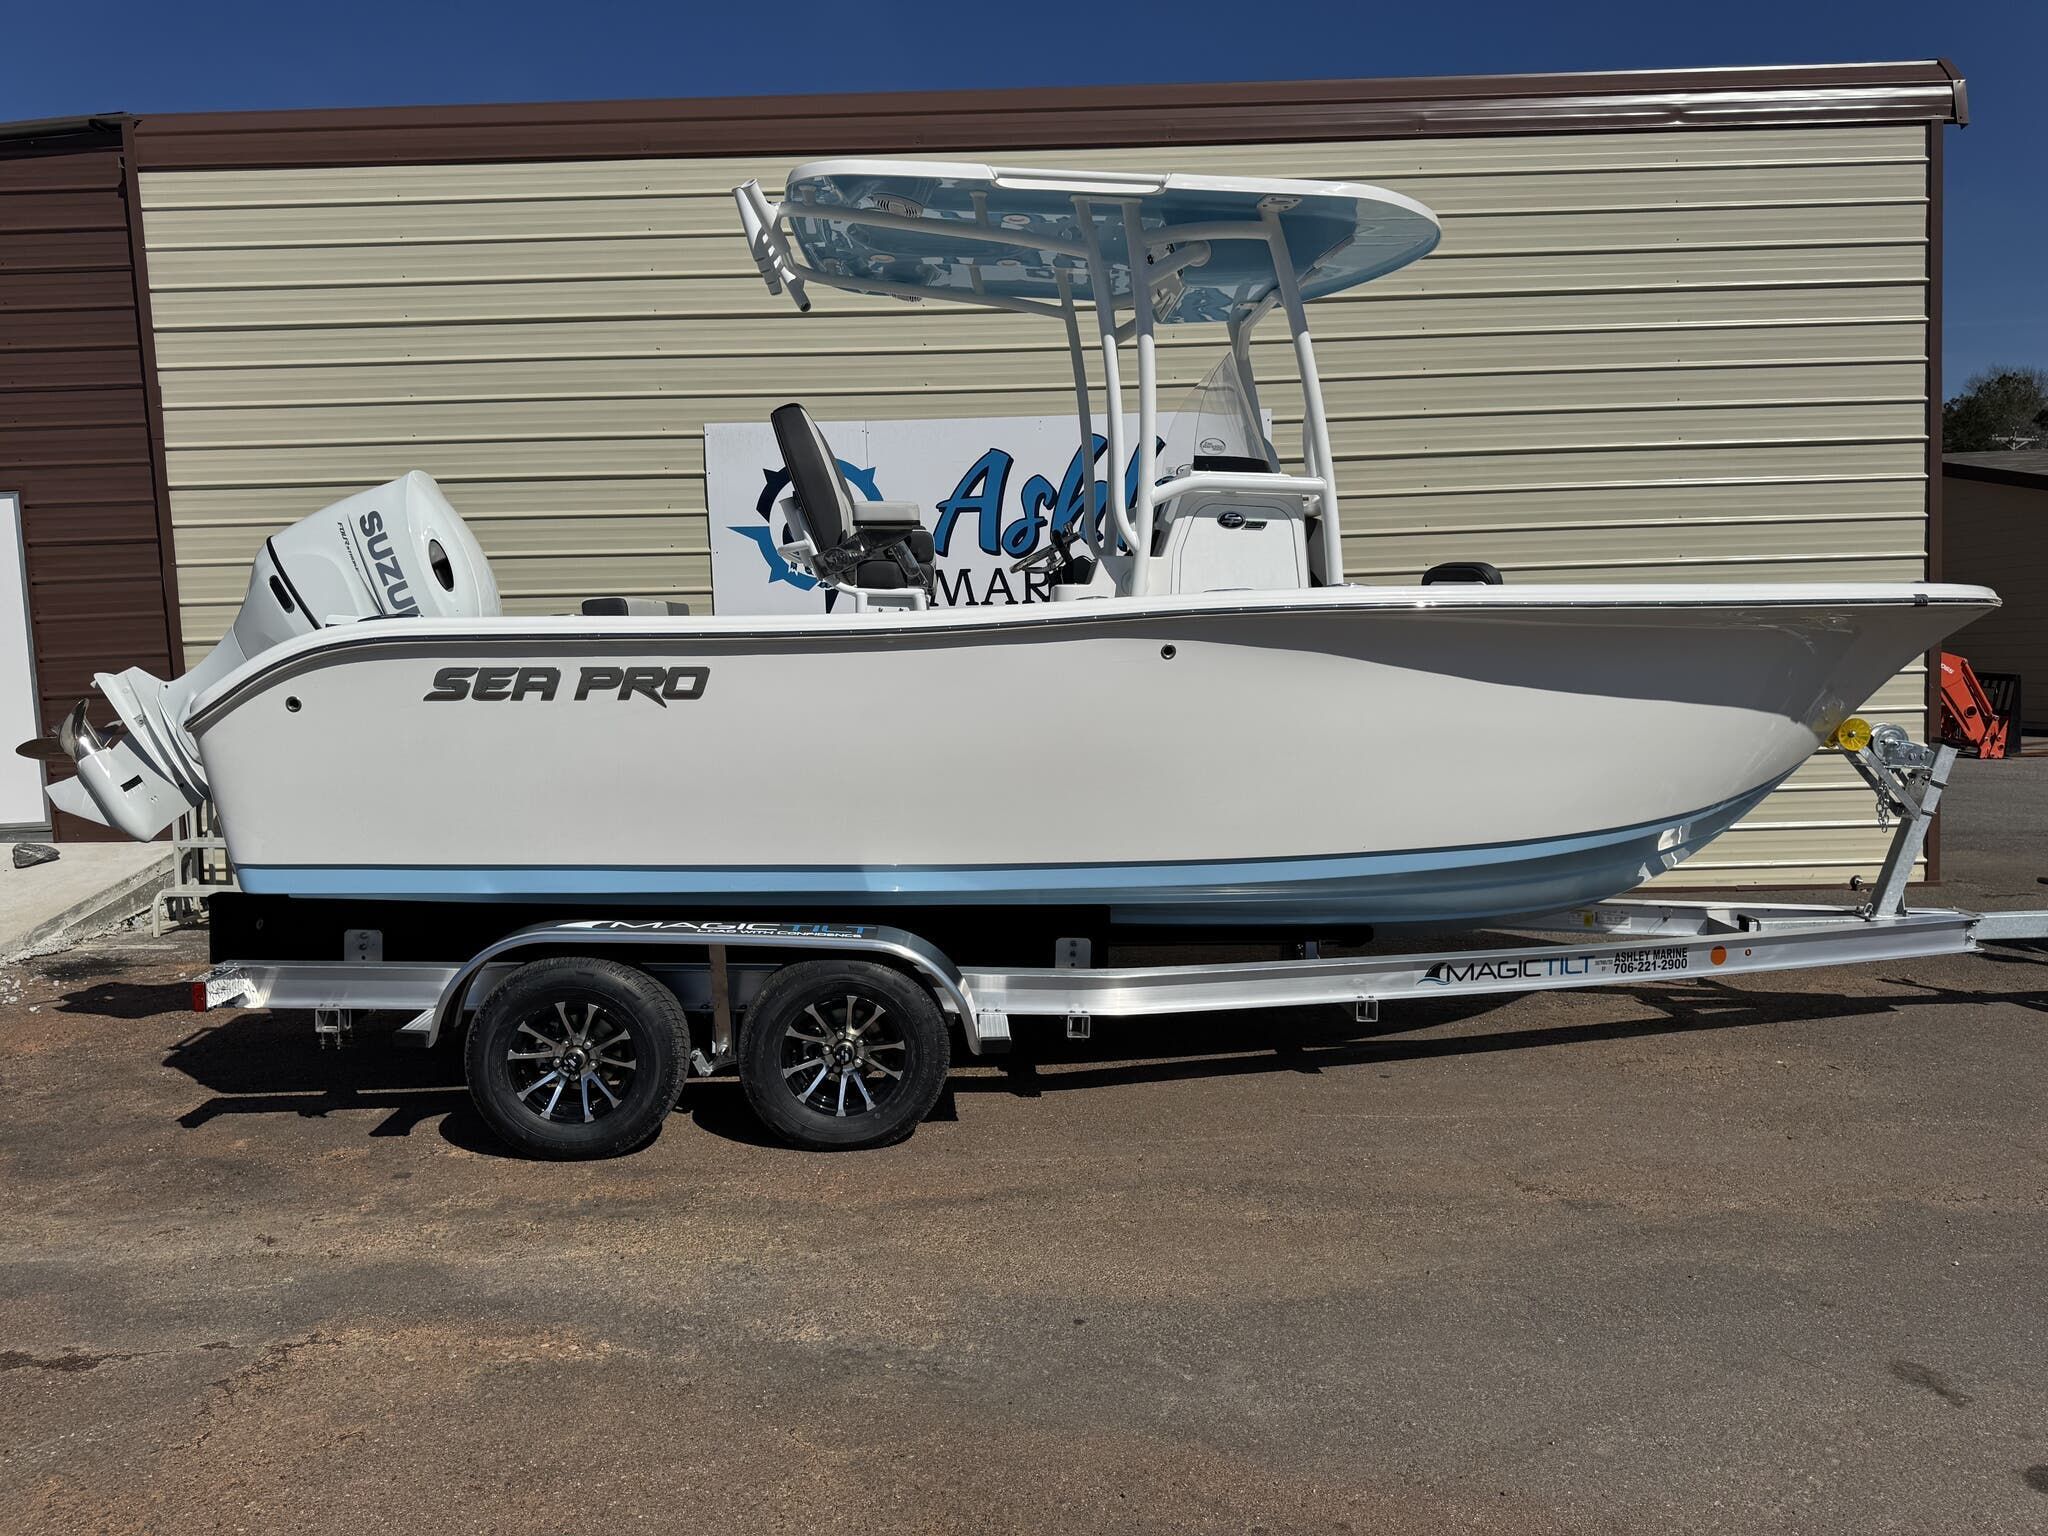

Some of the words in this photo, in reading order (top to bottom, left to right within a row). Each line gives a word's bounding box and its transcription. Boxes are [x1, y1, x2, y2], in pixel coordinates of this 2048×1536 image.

[933, 433, 1166, 559] Ashl
[932, 567, 1050, 606] MAR
[423, 667, 561, 701] SEA
[574, 667, 710, 708] PRO
[610, 920, 876, 934] MAGICTILT
[1447, 955, 1595, 982] MAGICTILT
[1614, 949, 1651, 963] ASHLEY
[1653, 947, 1688, 960] MARINE
[1614, 958, 1688, 974] 706-221-2900
